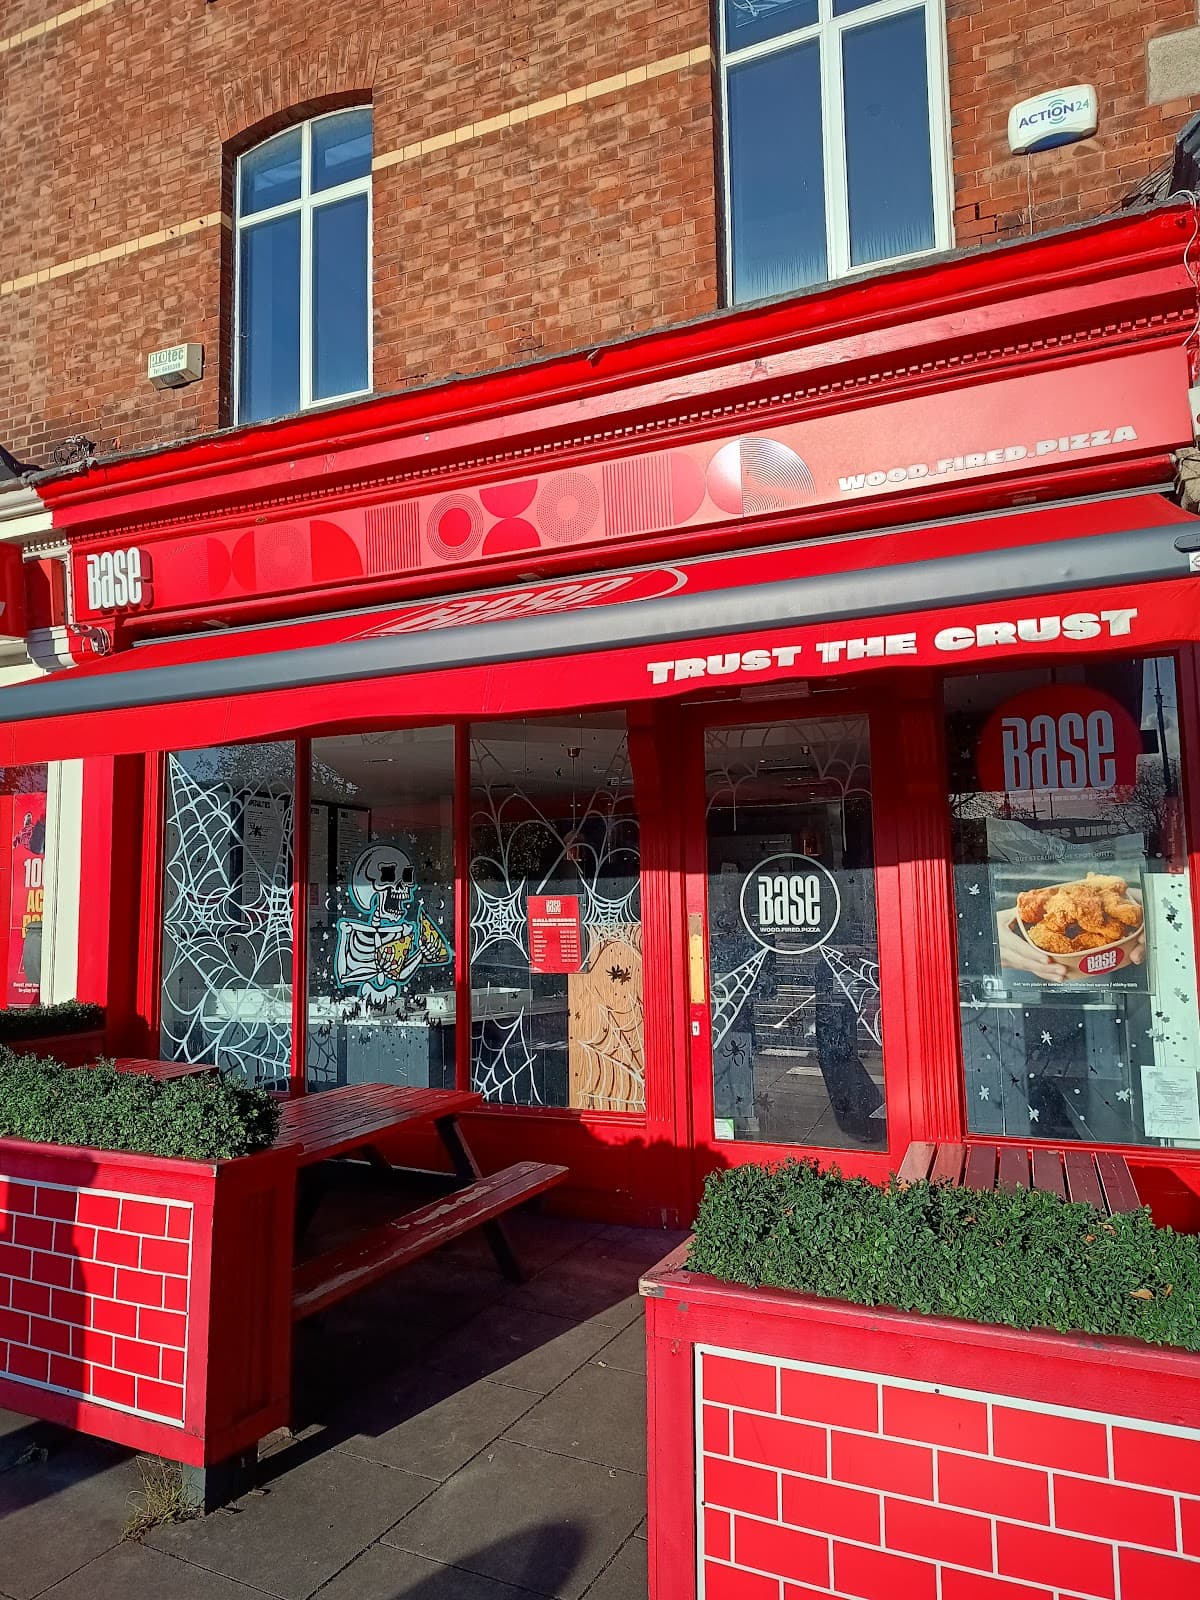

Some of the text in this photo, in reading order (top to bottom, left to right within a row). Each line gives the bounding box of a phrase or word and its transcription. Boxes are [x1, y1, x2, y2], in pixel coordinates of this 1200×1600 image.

[1019, 99, 1089, 129] ACTION24
[838, 424, 1139, 492] WOOD.FIRED.PIZZA
[647, 608, 1138, 685] TRUST THE CRUST
[24, 858, 45, 888] 10
